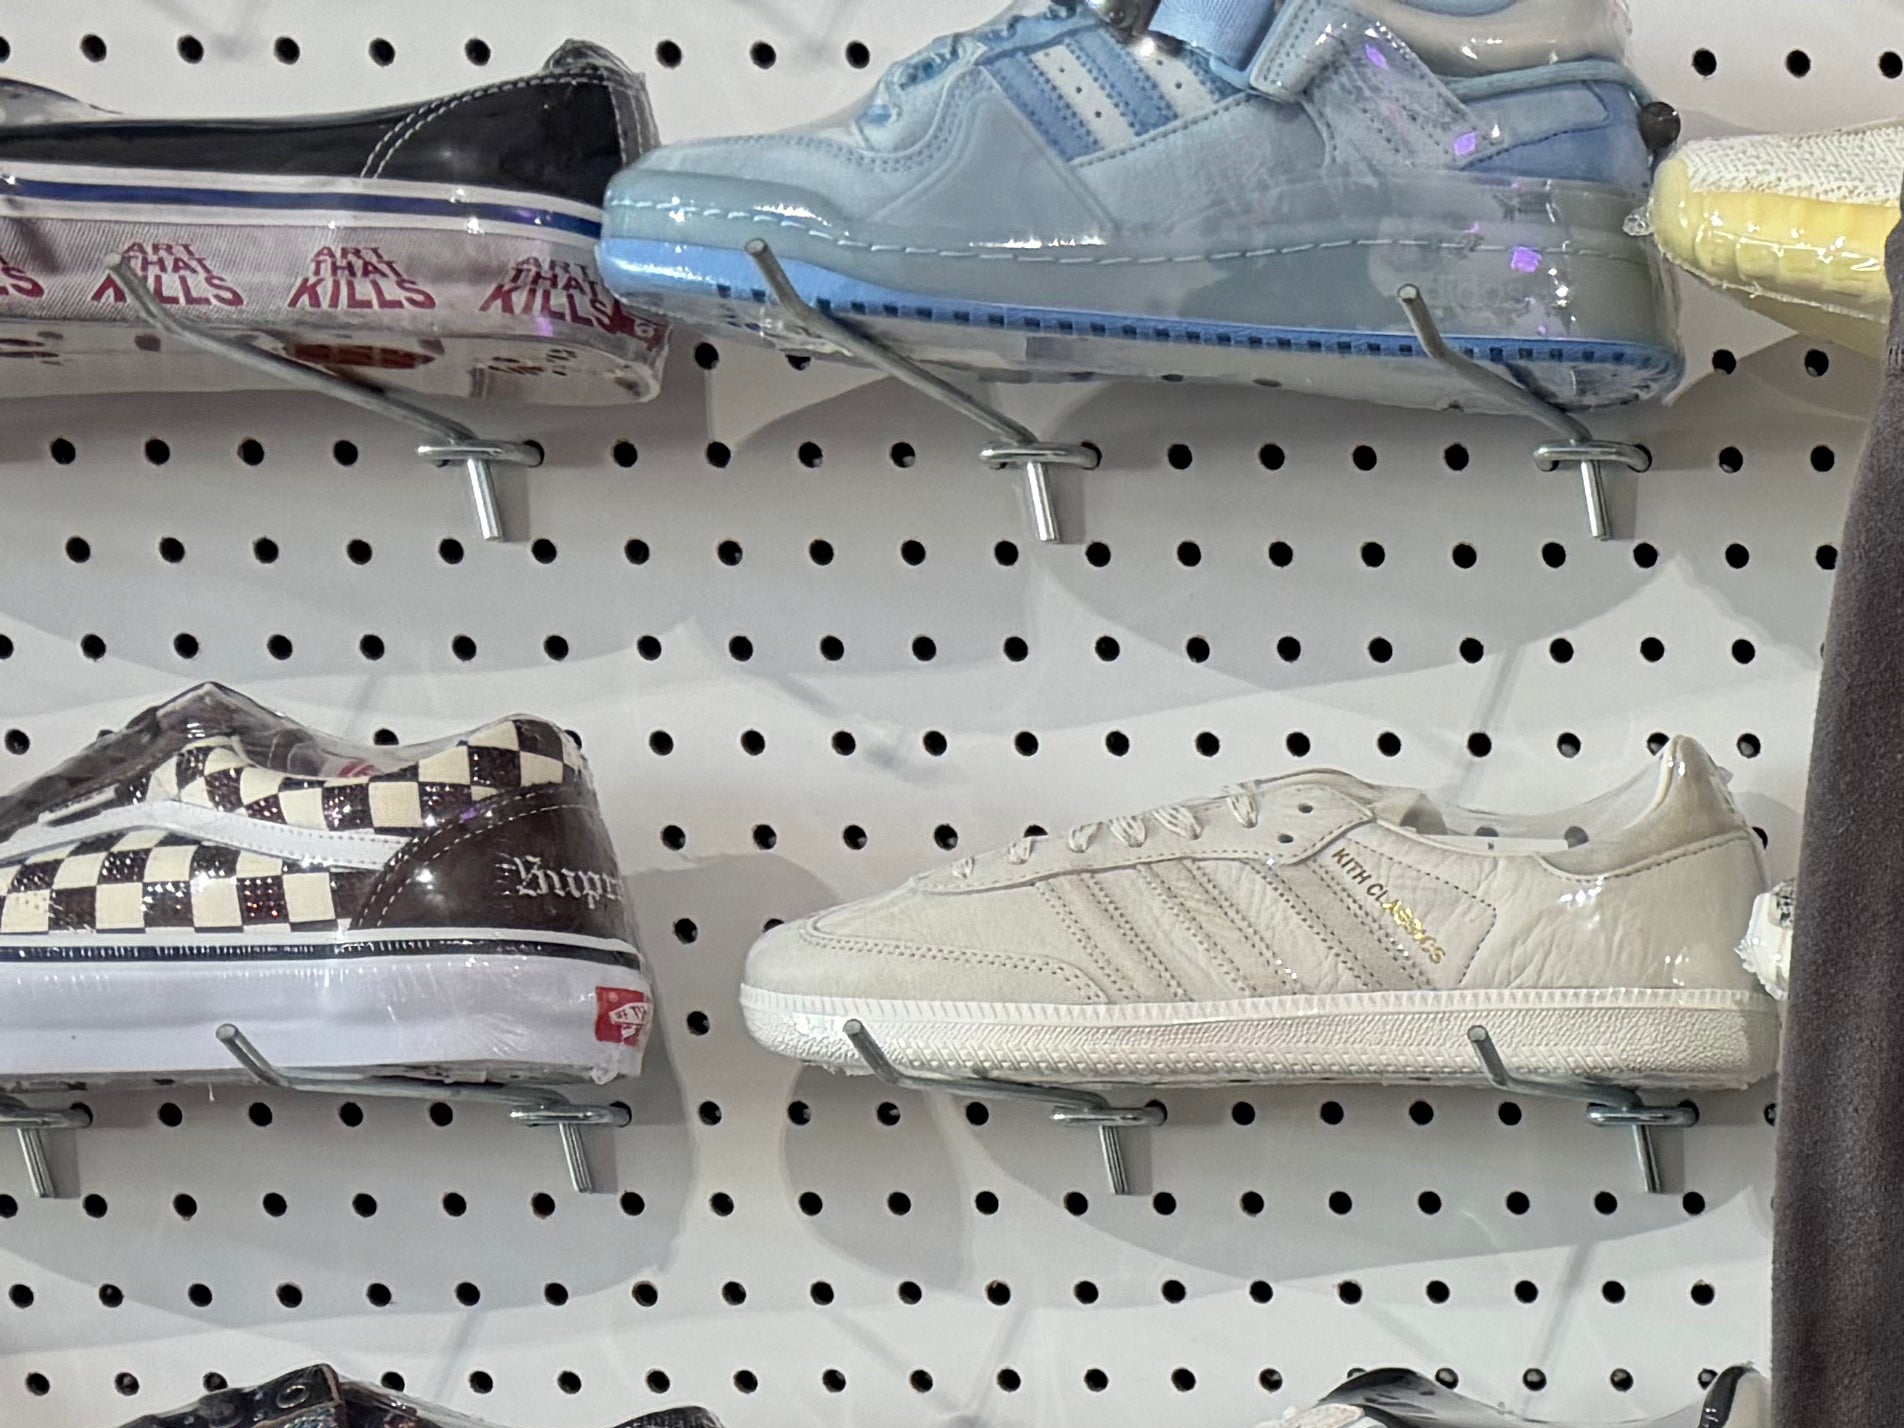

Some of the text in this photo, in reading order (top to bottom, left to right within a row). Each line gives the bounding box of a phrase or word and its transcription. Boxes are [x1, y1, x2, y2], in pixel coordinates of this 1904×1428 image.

[123, 242, 196, 257] ART
[311, 246, 384, 260] ART
[310, 259, 405, 279] THAT
[511, 264, 600, 300] THAT
[515, 256, 590, 278] ART
[89, 271, 243, 307] KLLS
[287, 277, 437, 309] KILLS
[479, 283, 616, 334] KILLS
[1331, 847, 1372, 885] KITH
